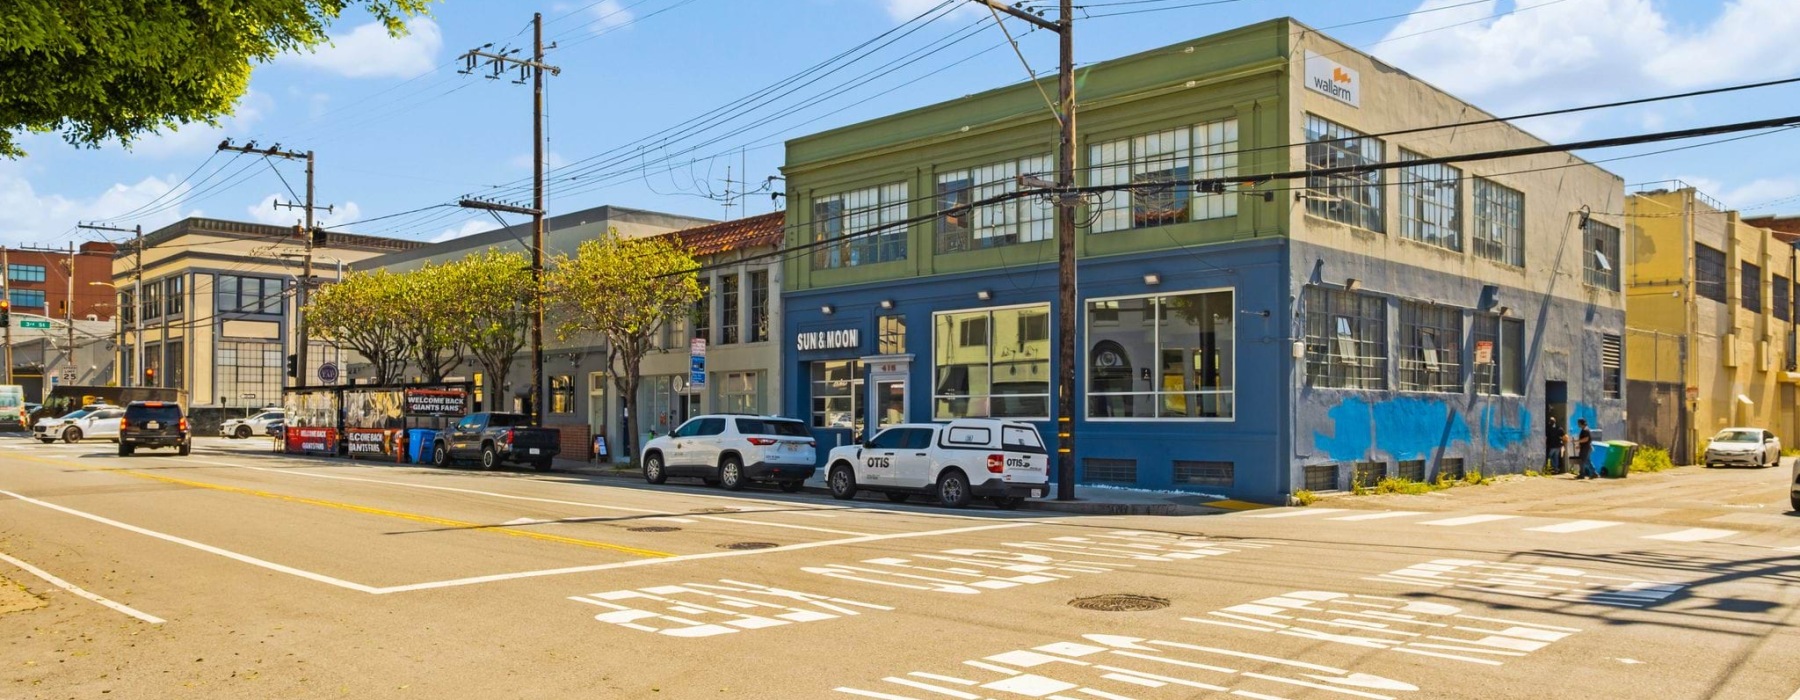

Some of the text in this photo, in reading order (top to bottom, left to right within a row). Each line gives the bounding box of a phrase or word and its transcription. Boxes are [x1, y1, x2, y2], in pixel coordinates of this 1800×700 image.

[1314, 76, 1351, 102] wallarm
[797, 329, 859, 351] SUN & MOON
[867, 457, 890, 468] OTIS
[1006, 458, 1023, 467] OTIS
[568, 578, 895, 637] KEEP
[1181, 590, 1583, 665] KEEP
[832, 634, 1420, 700] CLEA
